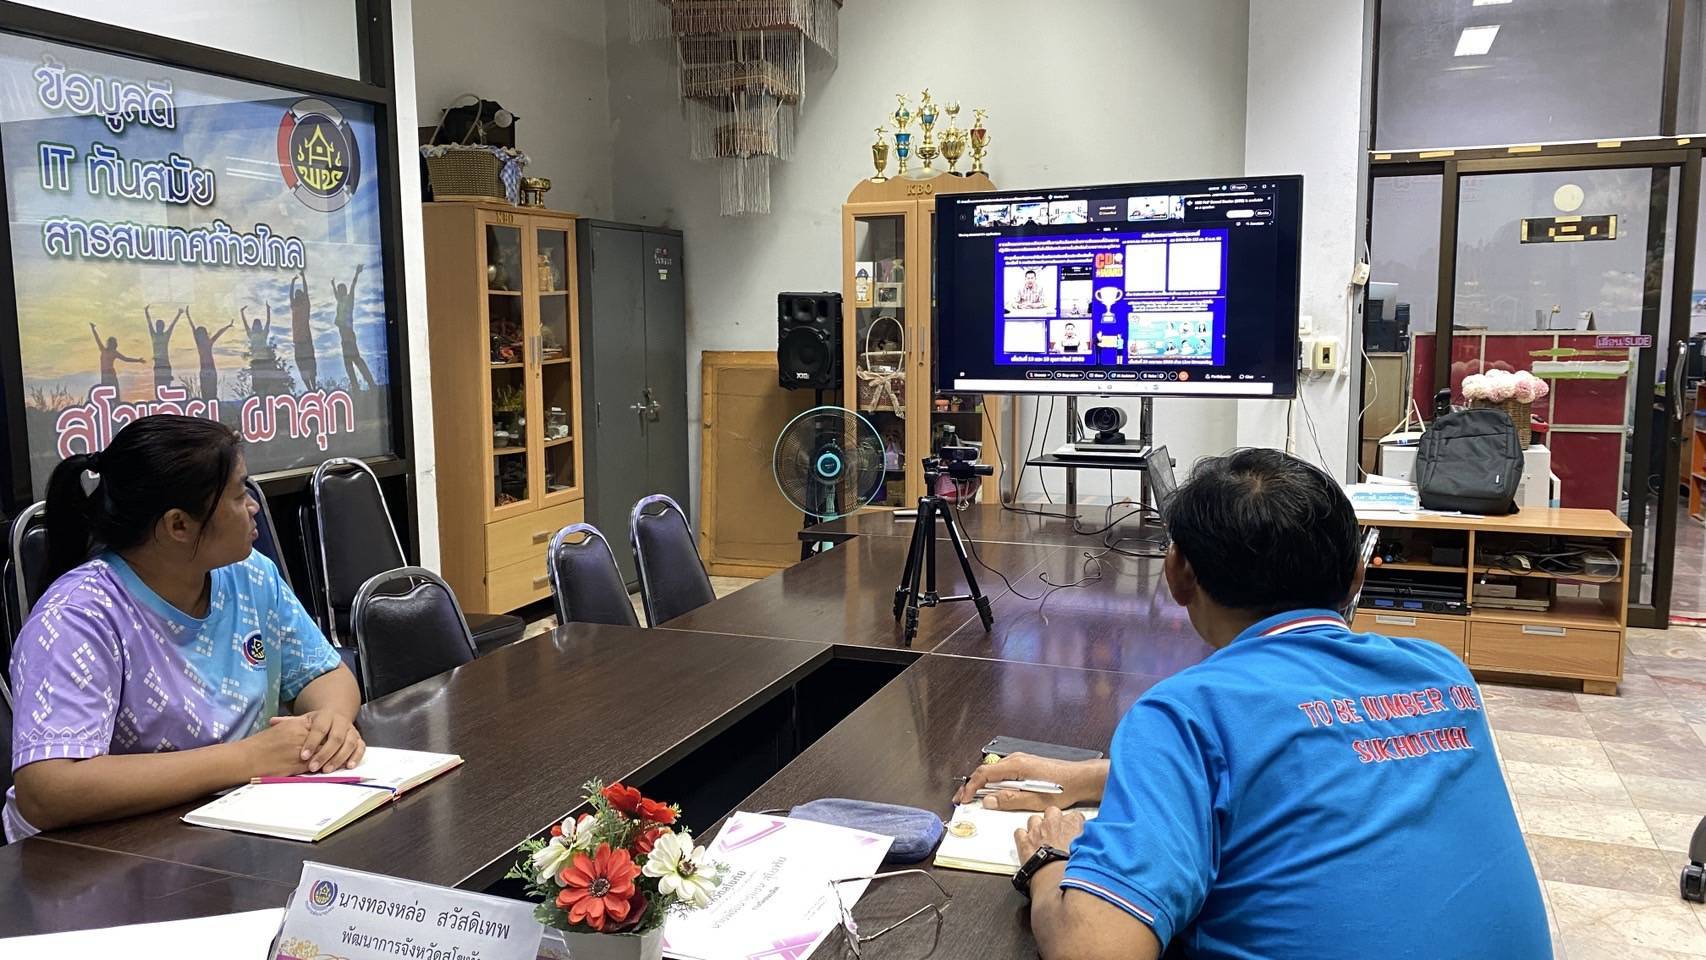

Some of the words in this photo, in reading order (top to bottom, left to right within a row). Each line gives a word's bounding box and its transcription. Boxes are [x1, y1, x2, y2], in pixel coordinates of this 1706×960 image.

[34, 56, 175, 132] ข้อมูลดี
[40, 144, 75, 190] IT
[88, 145, 216, 206] ทันสมัย
[45, 219, 306, 268] สารสนเทศก้าวไกล
[1624, 336, 1649, 346] SLIDE
[242, 390, 354, 451] ผาสุก
[1299, 701, 1333, 728] TO
[1333, 698, 1363, 724] BE
[1359, 686, 1448, 722] NUMBER
[1448, 685, 1480, 711] ONE
[1352, 726, 1474, 763] SUKHOTHAI
[338, 892, 426, 923] นางทองหล่อ
[436, 906, 510, 940] สวัสดิเทพ
[341, 925, 480, 960] พัฒนาการจังหวัดสโขั
